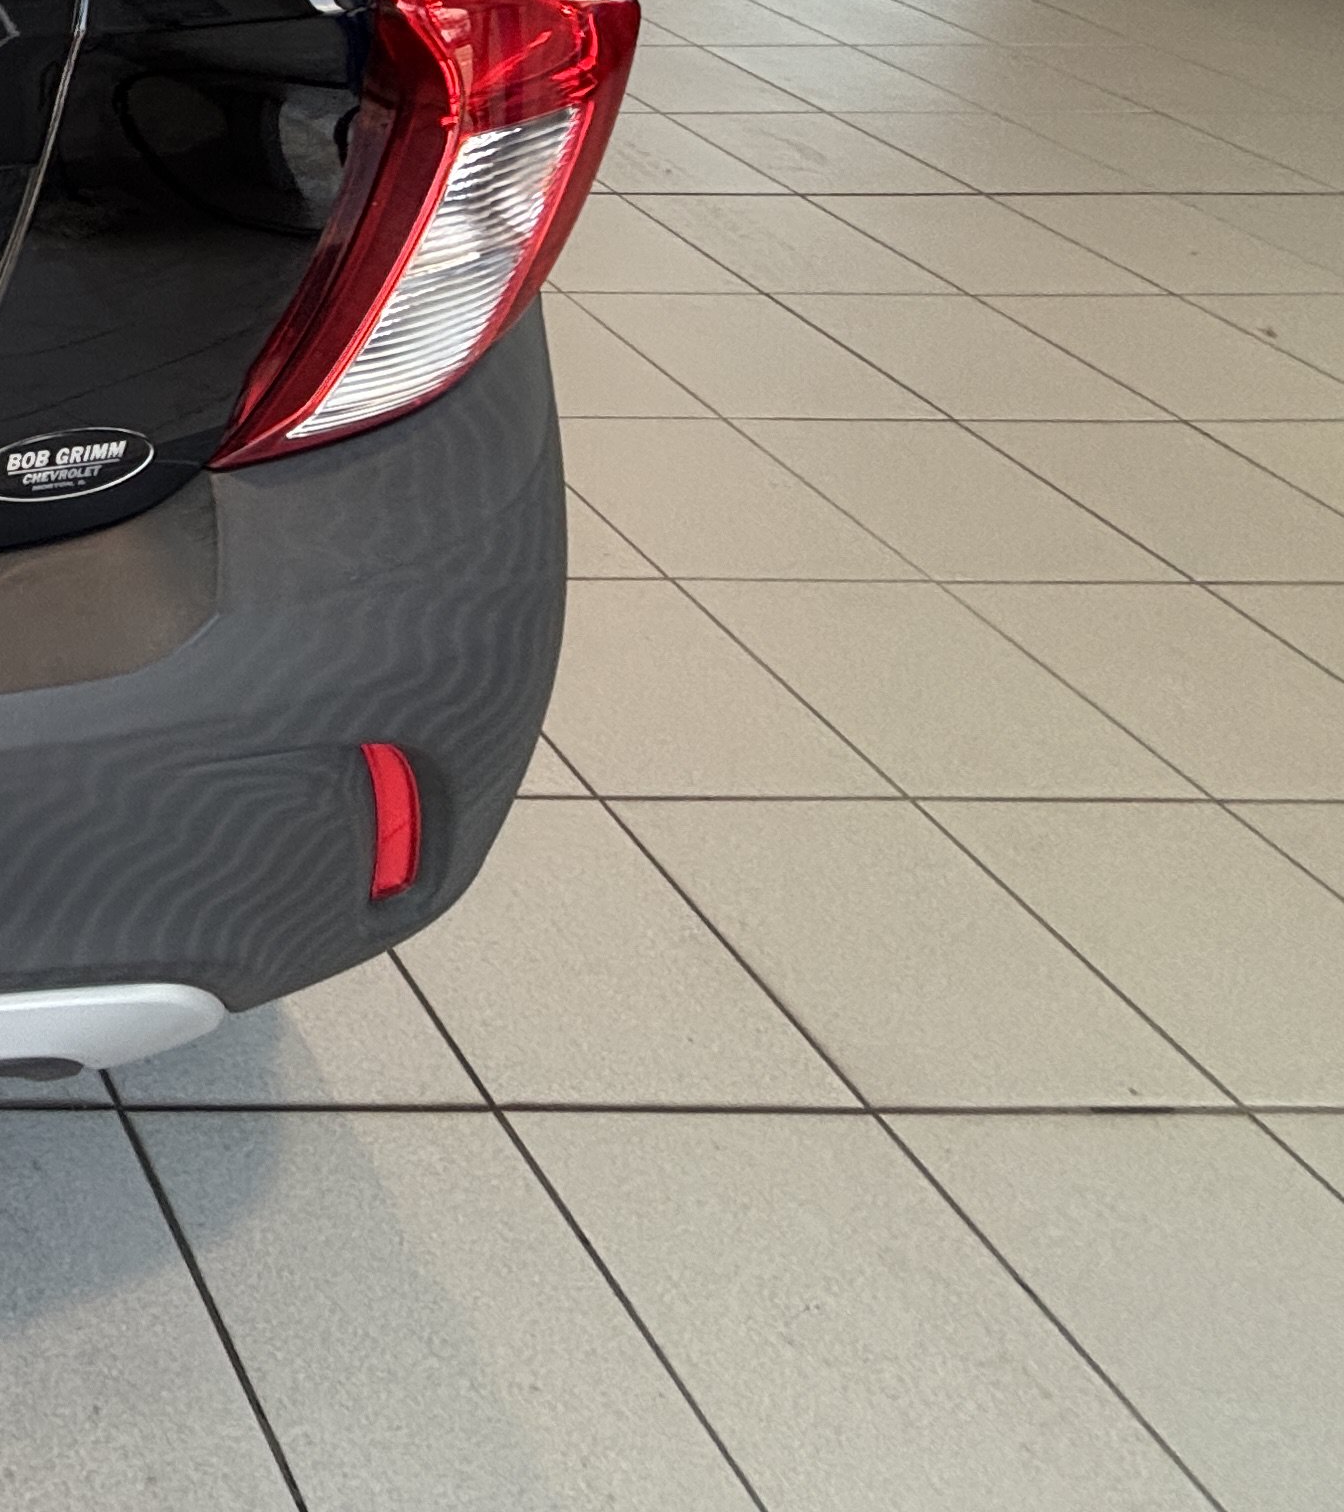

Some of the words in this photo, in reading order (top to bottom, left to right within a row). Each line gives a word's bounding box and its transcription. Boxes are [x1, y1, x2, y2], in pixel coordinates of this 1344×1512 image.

[7, 450, 51, 471] BOB
[56, 440, 127, 465] GRIMM
[22, 465, 102, 485] CHEVROLET
